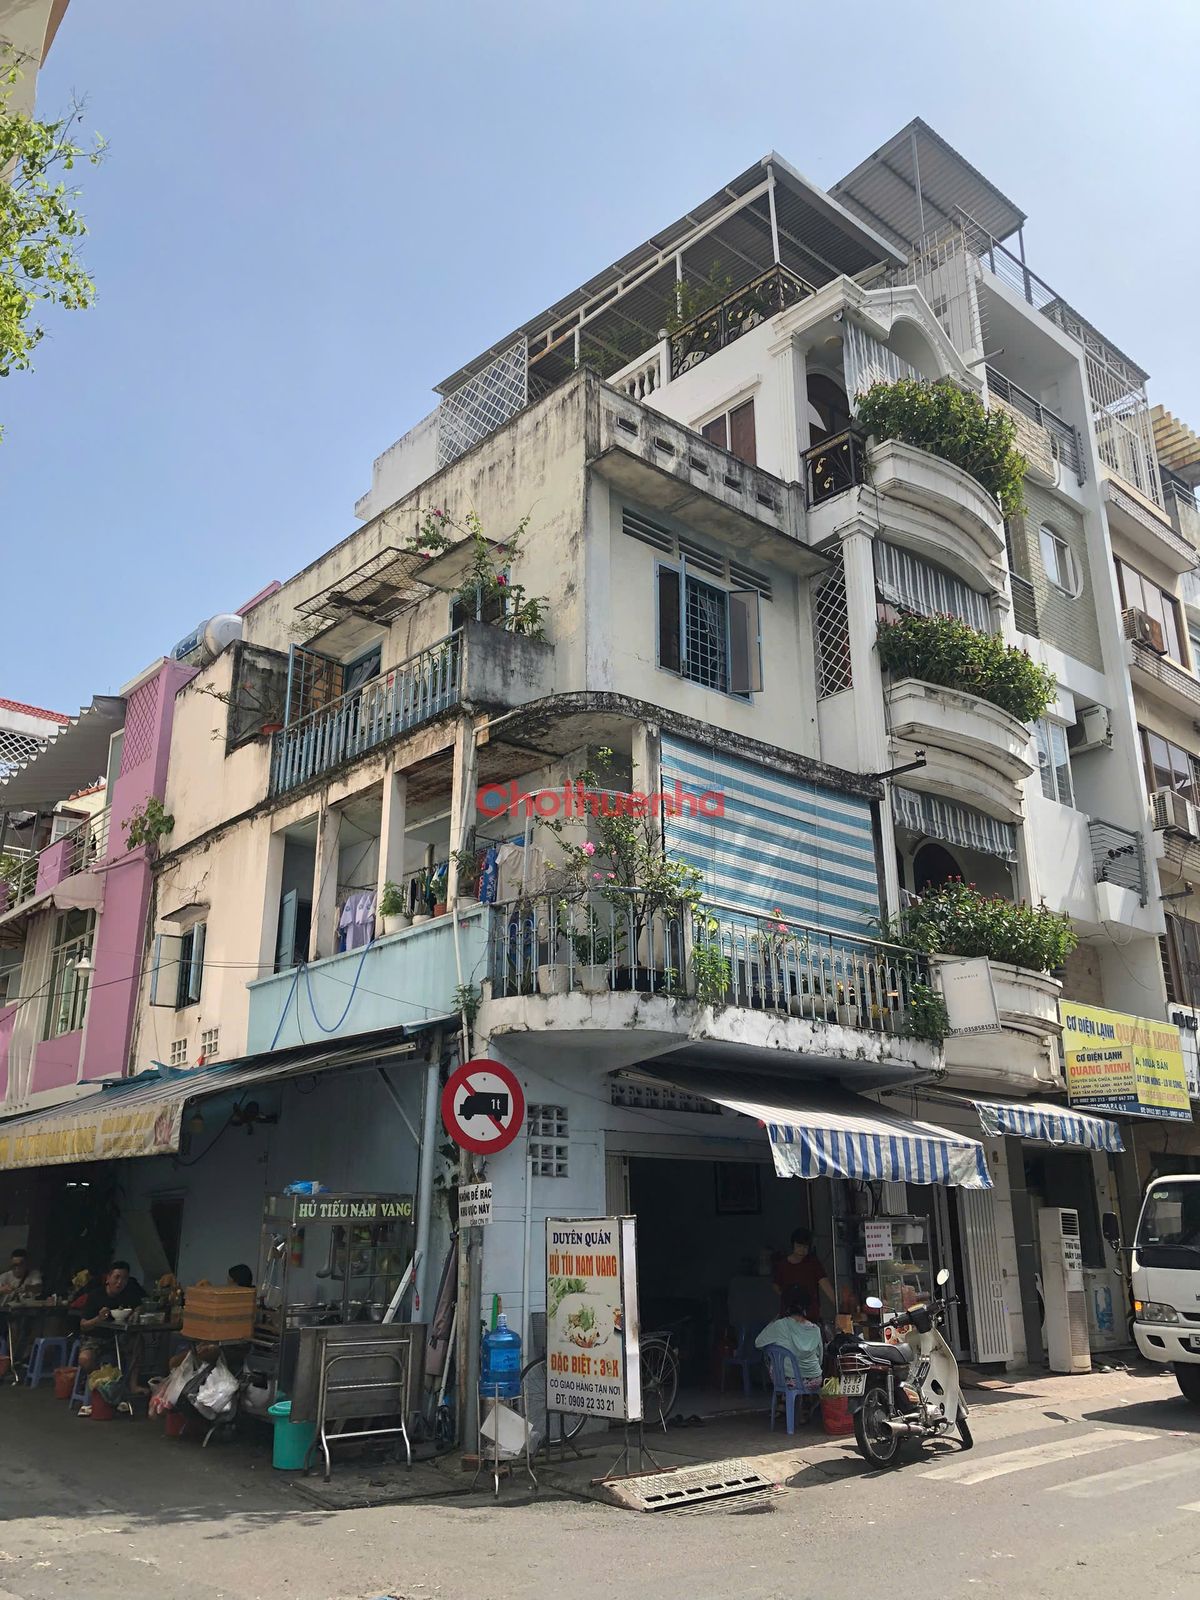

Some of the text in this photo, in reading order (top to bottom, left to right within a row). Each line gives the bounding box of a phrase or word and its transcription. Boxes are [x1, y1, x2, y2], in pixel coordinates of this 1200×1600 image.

[1070, 1062, 1131, 1077] QUANG MINH
[491, 1099, 500, 1110] 1t
[471, 1185, 478, 1200] ĐỂ
[480, 1187, 492, 1199] RÁC
[299, 1199, 412, 1218] HỦ TIẾU NAM VANG
[478, 1202, 490, 1214] NÀY
[552, 1228, 611, 1247] DUYÊN QUÁN
[549, 1248, 617, 1277] HỦ TÍU NAM VANG
[551, 1352, 569, 1375] ĐẶC
[571, 1353, 591, 1378] BIỆT
[560, 1380, 575, 1390] GIAO
[576, 1380, 594, 1393] HÀNG
[595, 1383, 607, 1395] TẬN
[608, 1386, 621, 1395] NƠI
[555, 1393, 615, 1411] ĐT: 0909 22 33 21
